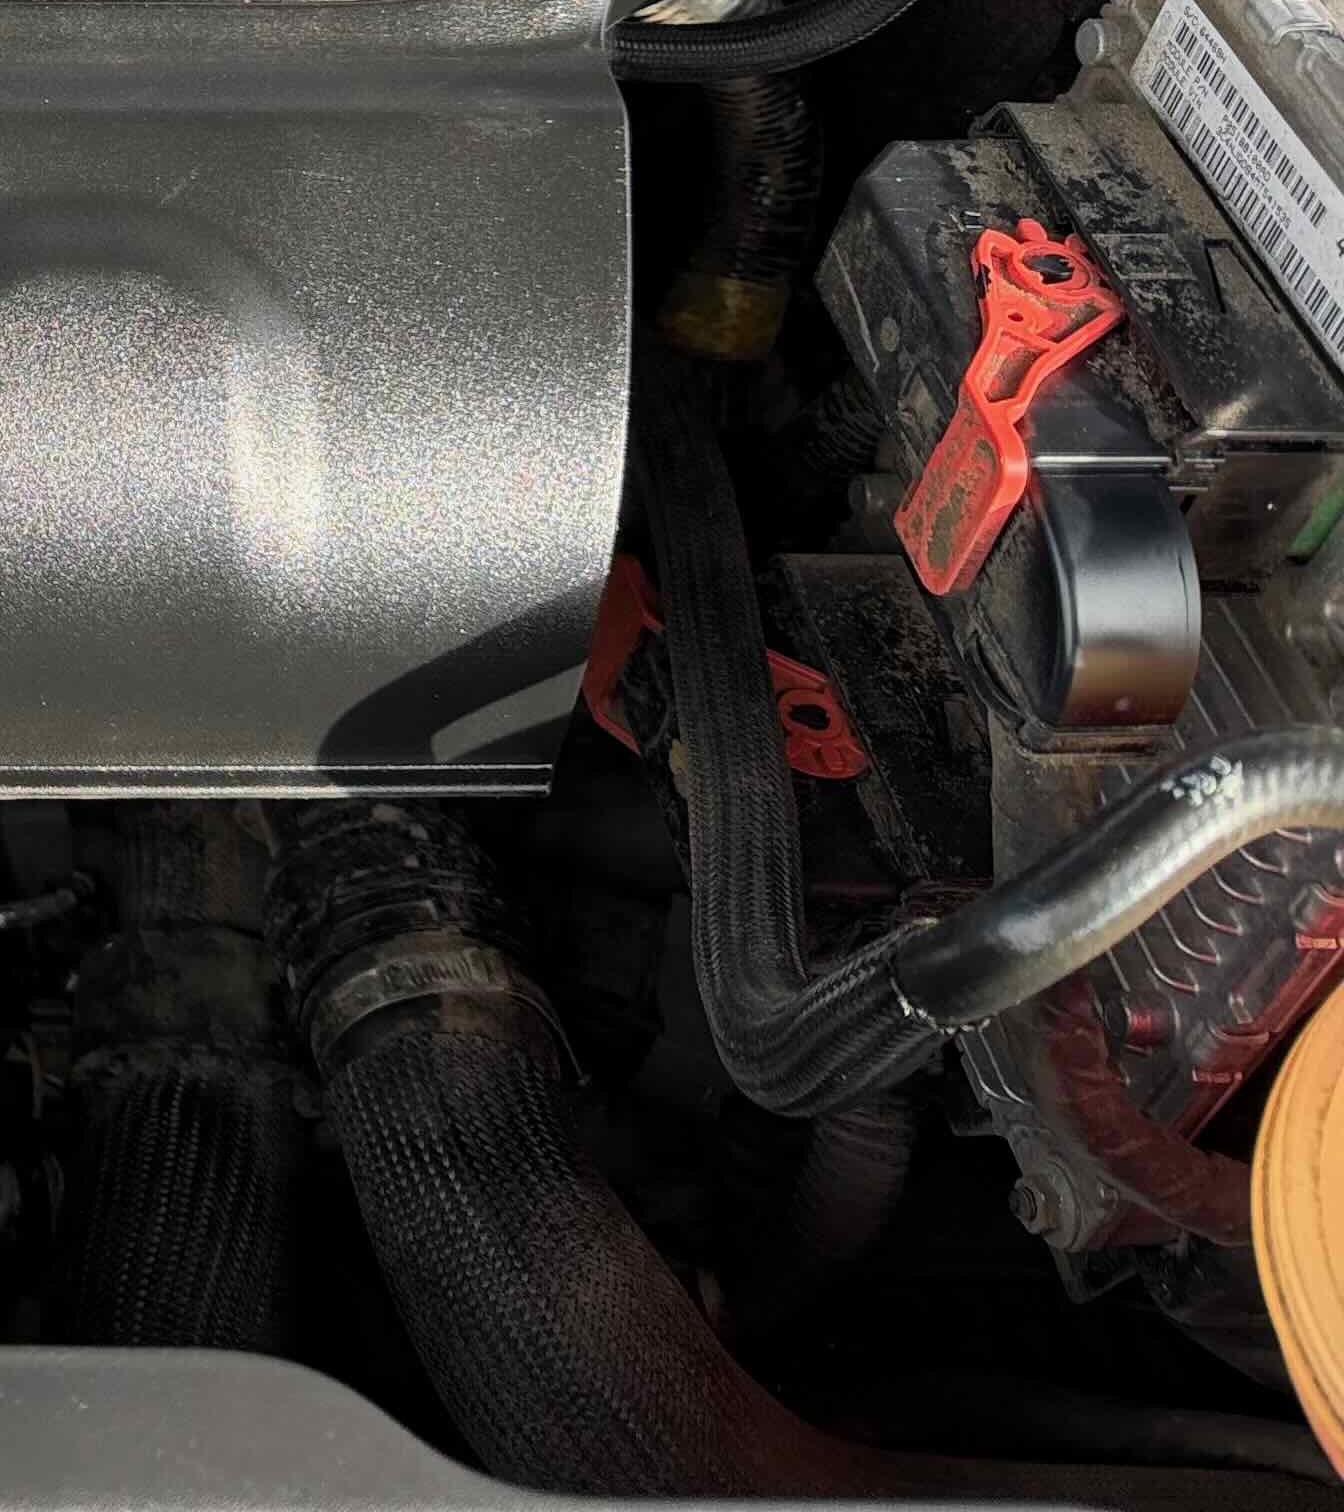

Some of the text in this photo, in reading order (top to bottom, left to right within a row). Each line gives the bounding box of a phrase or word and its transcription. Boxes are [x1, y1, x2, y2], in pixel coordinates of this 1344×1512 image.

[1159, 48, 1186, 87] MODULE
[1186, 84, 1204, 111] VIN
[1165, 38, 1192, 78] MODULE
[1192, 75, 1208, 99] P/N
